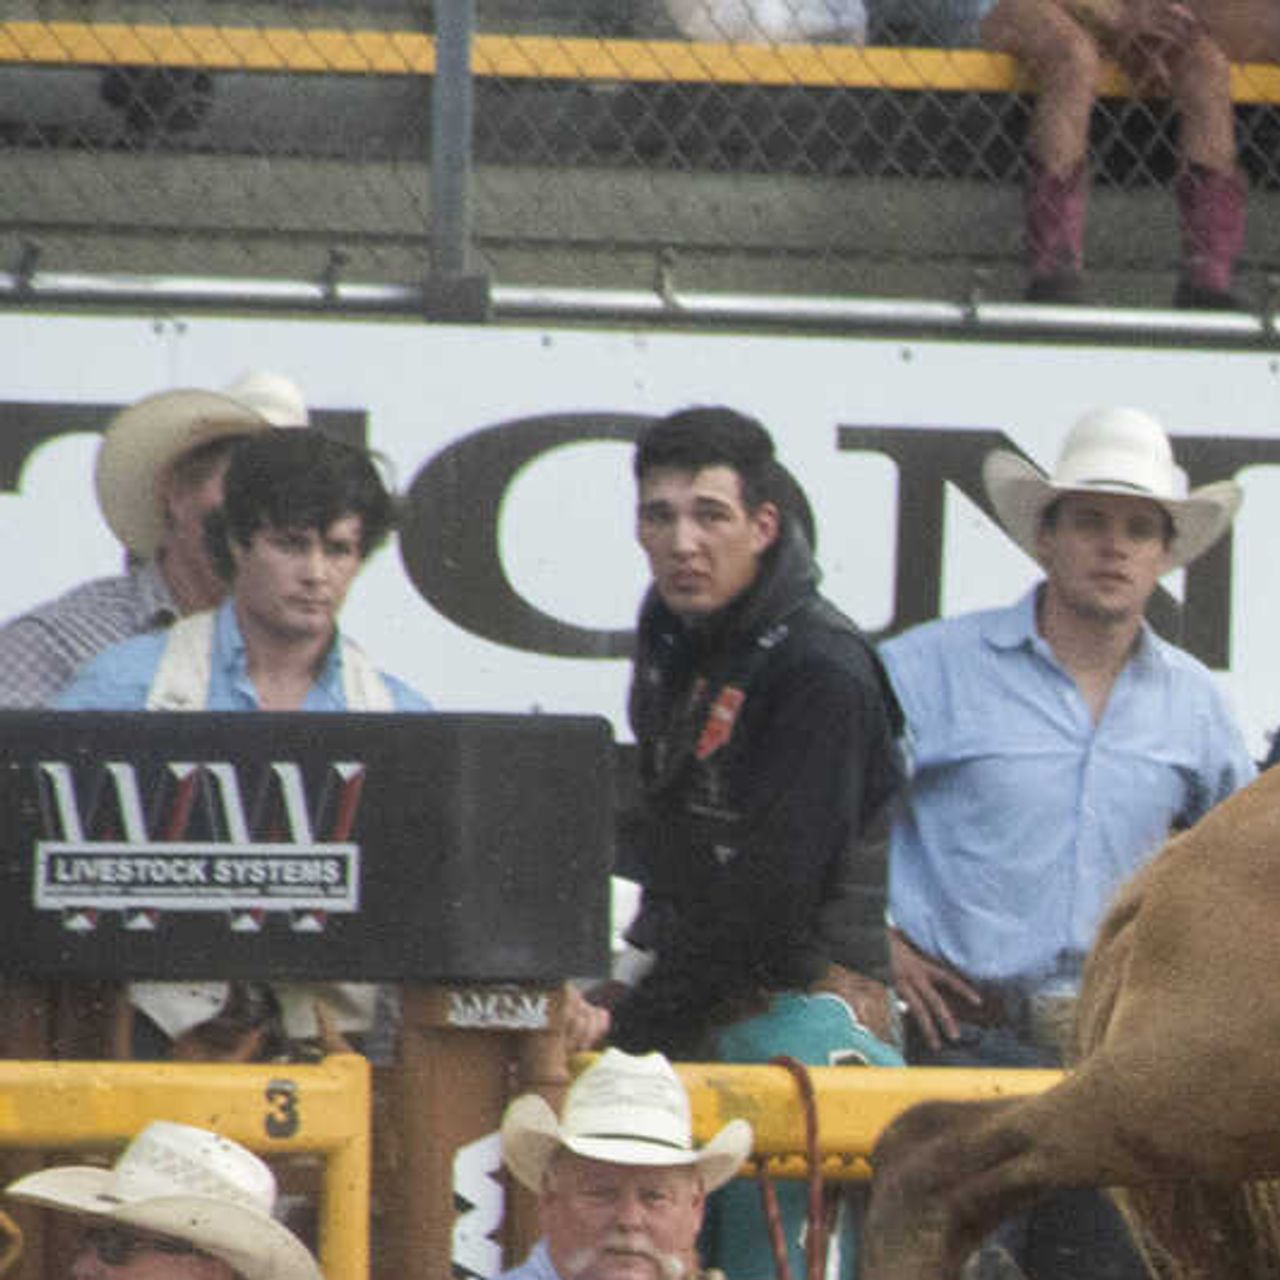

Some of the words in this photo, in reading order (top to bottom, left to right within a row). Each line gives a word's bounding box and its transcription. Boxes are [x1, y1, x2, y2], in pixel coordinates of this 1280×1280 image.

[54, 857, 205, 883] LIVESTOCK
[213, 859, 341, 884] SYSTEMS
[264, 1079, 300, 1139] 3
